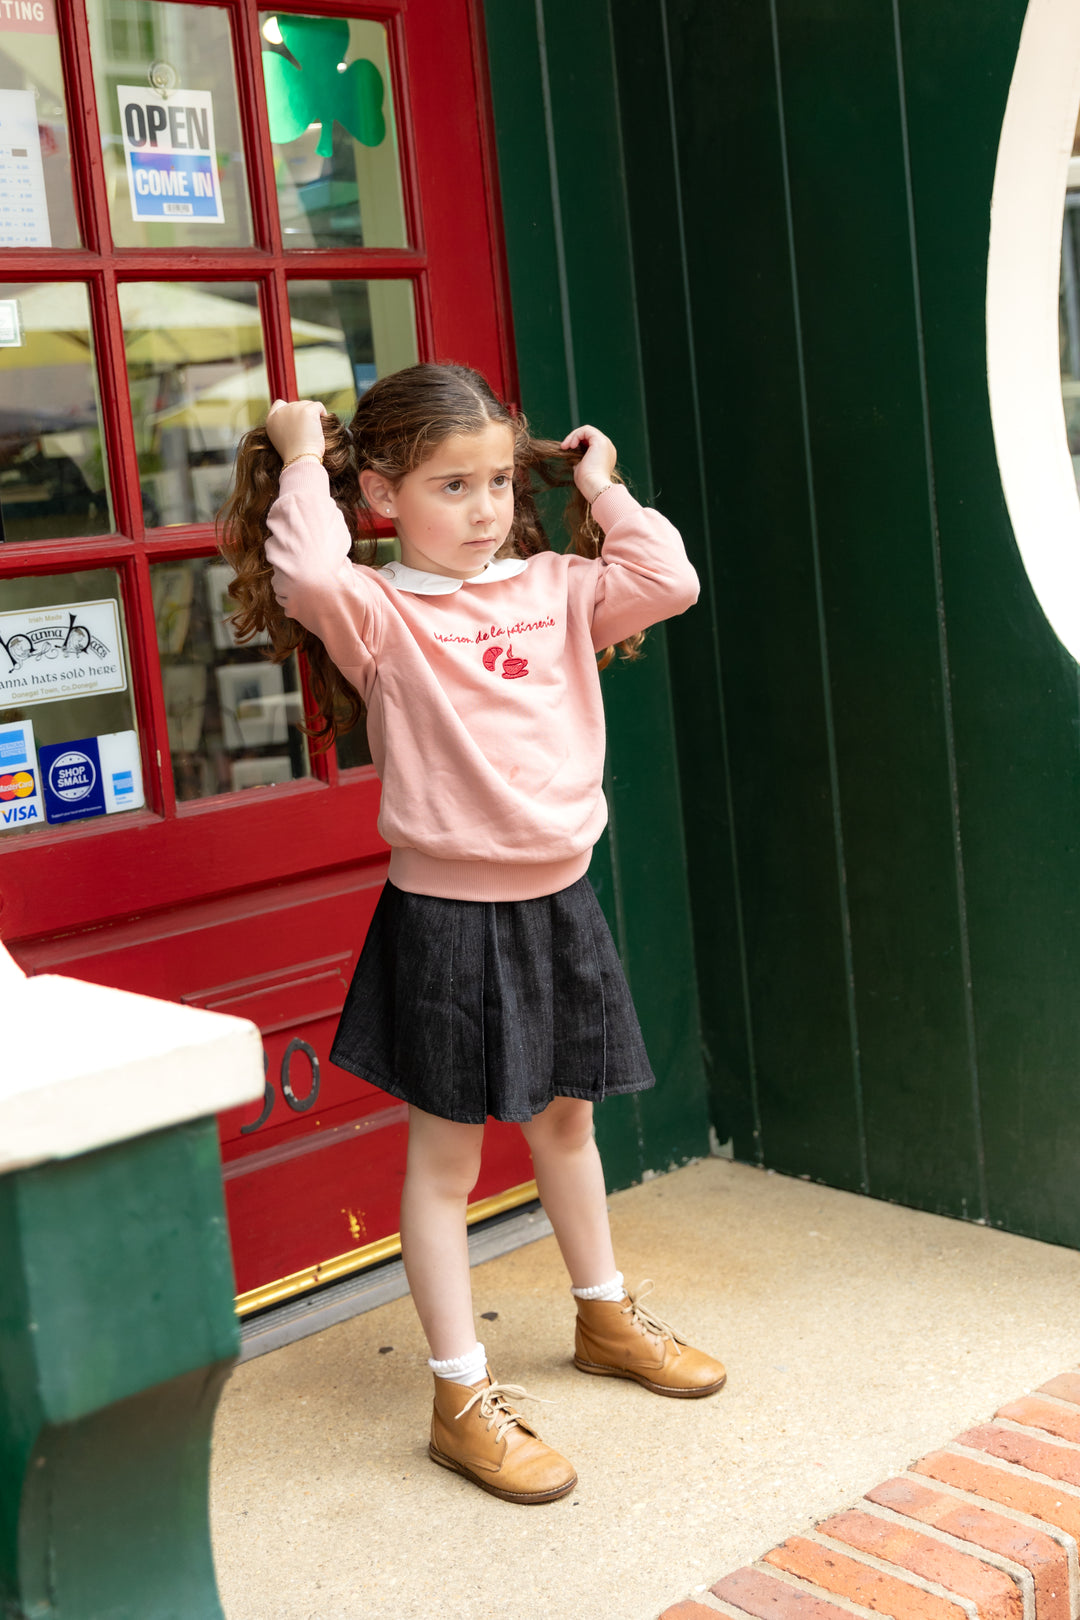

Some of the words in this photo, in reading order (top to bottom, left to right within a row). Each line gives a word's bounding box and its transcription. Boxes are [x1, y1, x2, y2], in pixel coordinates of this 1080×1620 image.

[0, 0, 45, 22] TING
[124, 103, 210, 150] OPEN
[135, 168, 189, 197] COME
[191, 172, 214, 198] IN
[475, 629, 490, 645] de
[490, 624, 506, 638] la
[0, 678, 28, 690] anna
[31, 672, 58, 685] hats
[60, 667, 86, 681] sold
[57, 774, 90, 788] SMALL
[58, 765, 86, 779] SHOP
[1, 804, 38, 823] VISA
